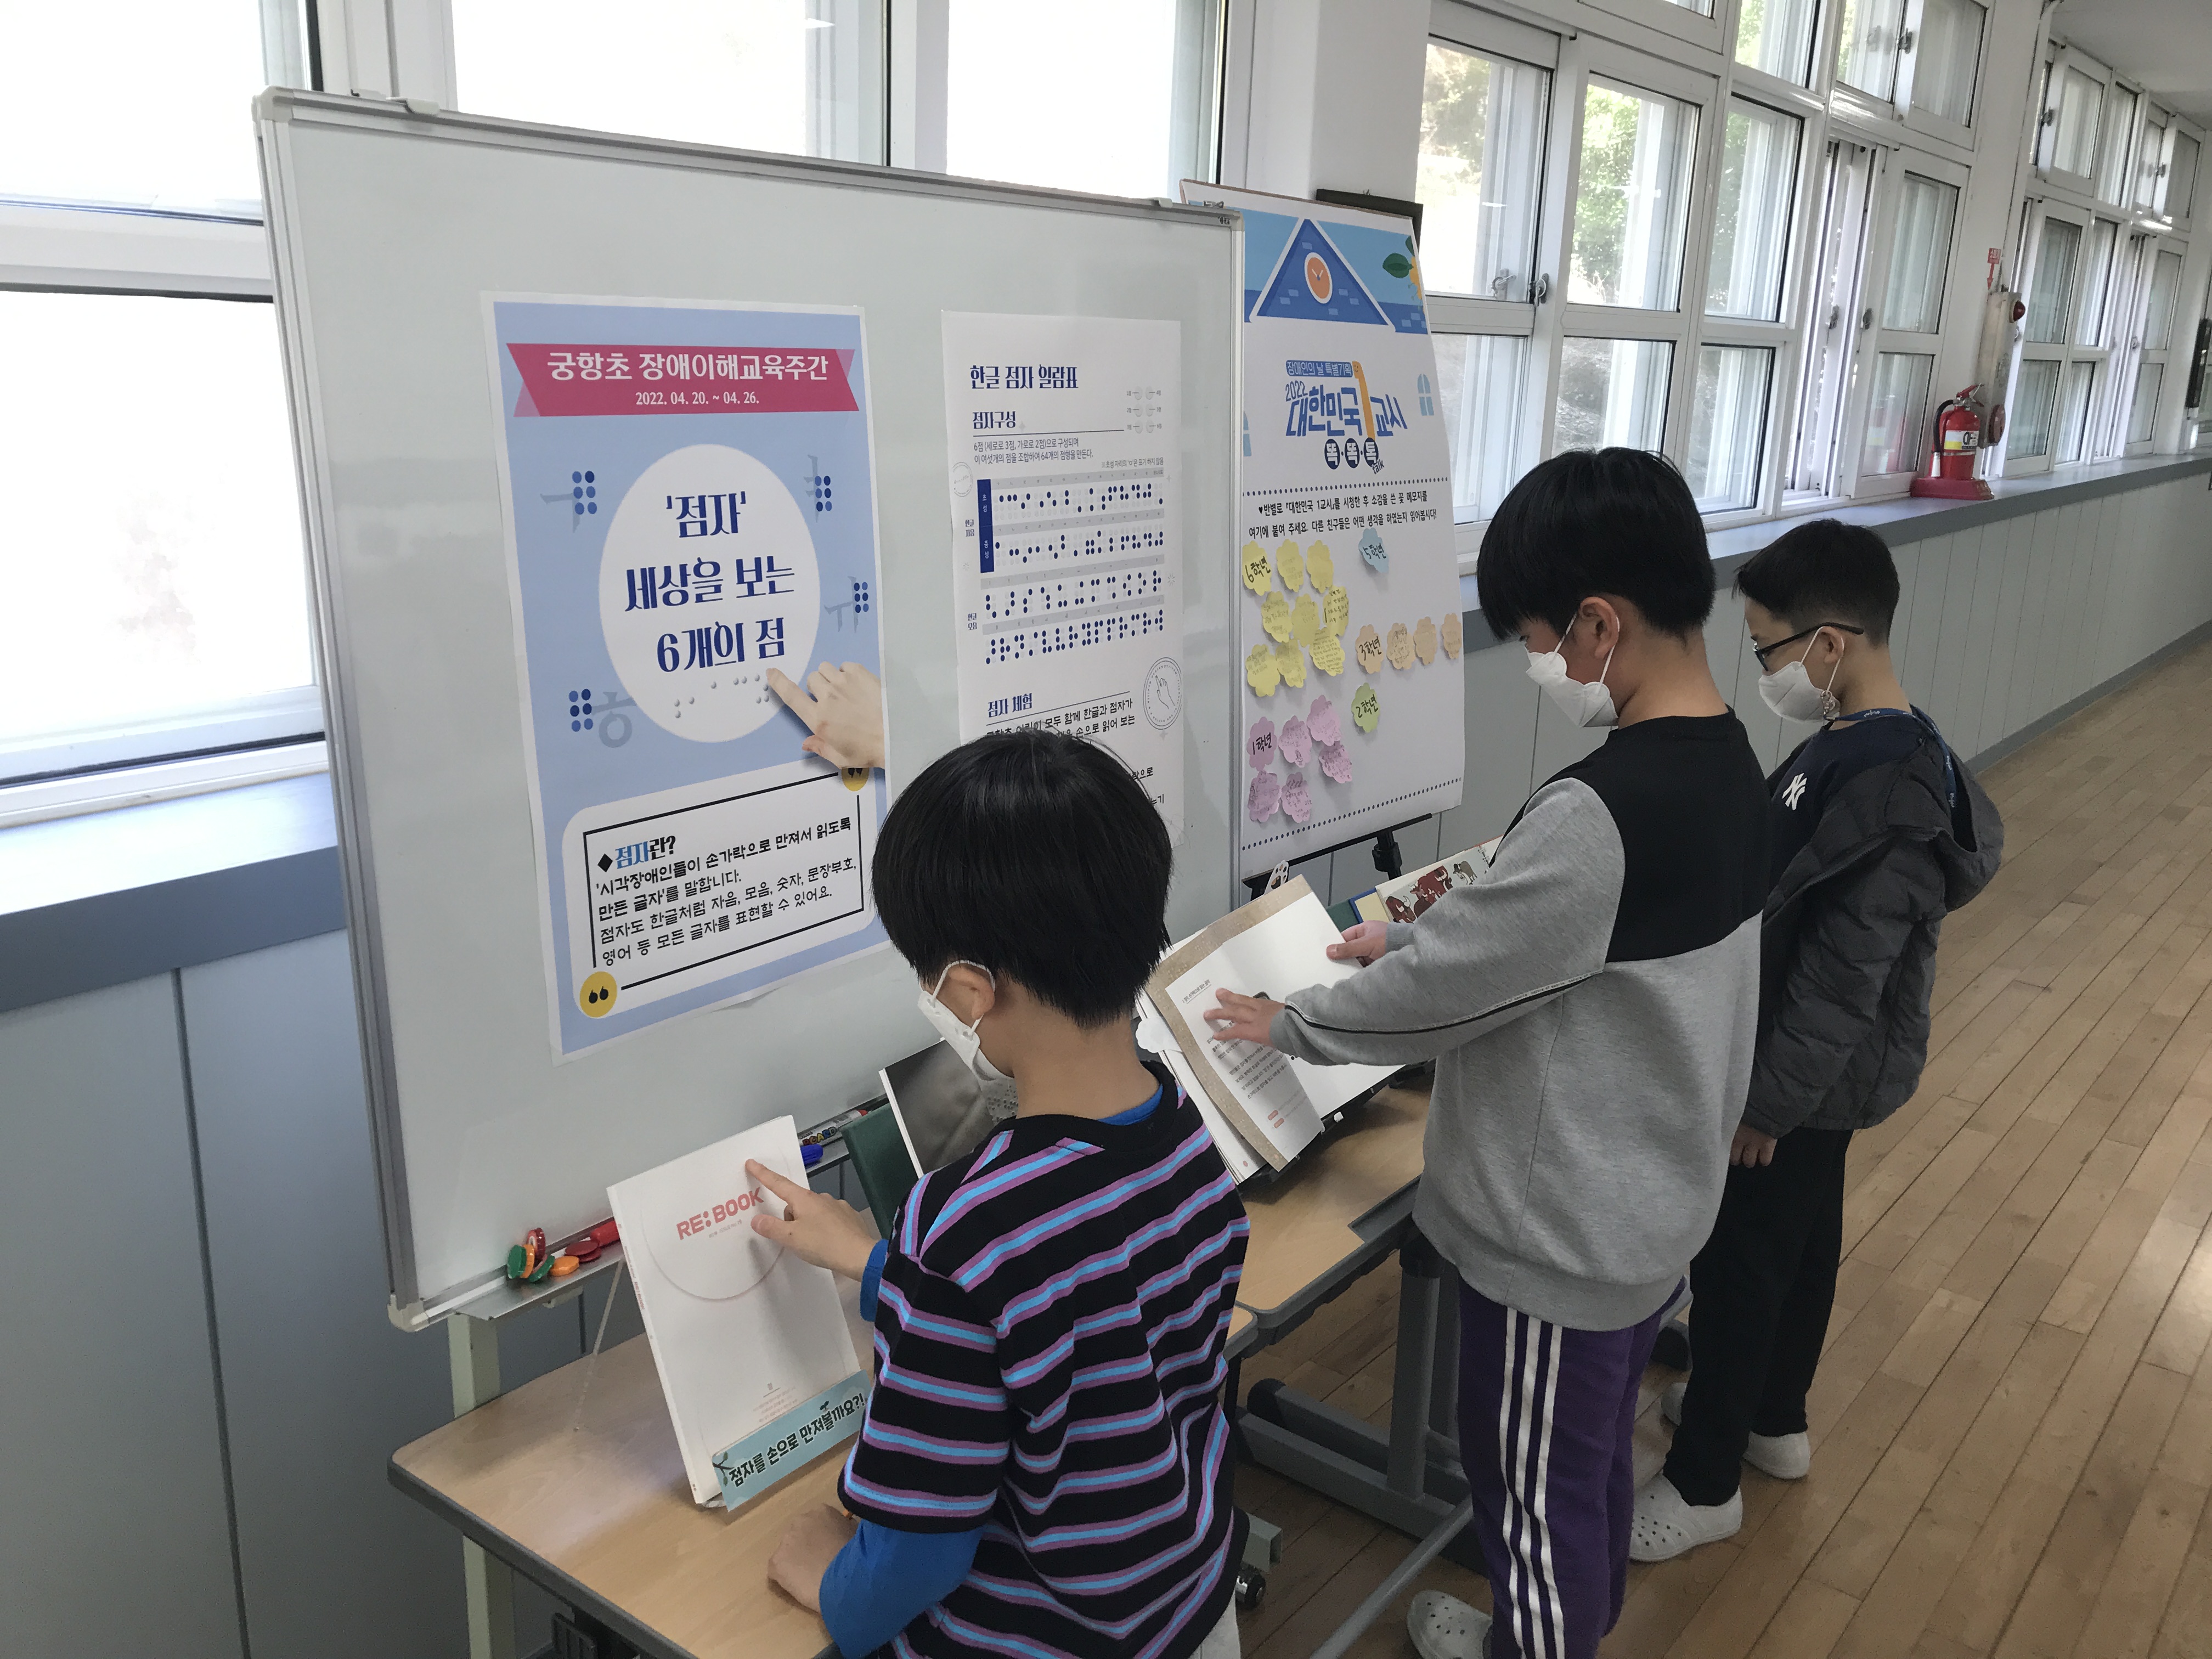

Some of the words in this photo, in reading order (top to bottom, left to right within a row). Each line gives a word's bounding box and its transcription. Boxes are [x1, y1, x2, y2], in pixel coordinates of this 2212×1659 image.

[547, 351, 633, 381] 궁항초
[639, 352, 829, 381] 장애이해교육주간
[969, 364, 1001, 389] 한글
[1005, 365, 1034, 389] 점자
[1038, 364, 1079, 389] 일람표
[1287, 362, 1316, 376] 장애인의
[1317, 362, 1324, 377] 날
[1325, 363, 1352, 377] 특별기획
[635, 391, 668, 406] 2022.
[670, 392, 689, 405] 04.
[692, 392, 709, 405] 20.
[723, 391, 741, 405] 04.
[743, 391, 760, 404] 26.
[1285, 380, 1308, 402] 2022
[972, 411, 1017, 430] 점자구성
[1285, 385, 1363, 437] 대한민국
[973, 442, 984, 452] 6점
[984, 441, 1005, 451] (세로로
[1017, 439, 1035, 449] 가로로
[1035, 438, 1058, 449] 2점)으로
[1058, 437, 1079, 448] 구성되며
[974, 454, 980, 465] 이
[981, 453, 1005, 465] 여섯개의
[1005, 453, 1017, 464] 점을
[1018, 452, 1040, 463] 조합하여
[1041, 450, 1059, 461] 64개의
[1076, 448, 1094, 460] 만든다.
[665, 490, 747, 539] '점자'
[1263, 503, 1284, 516] 반별로
[1343, 495, 1361, 509] 시청한
[1363, 494, 1369, 507] 후
[1372, 493, 1388, 506] 소감을
[1390, 493, 1396, 505] 쓴
[1406, 490, 1427, 503] 메모지를
[1249, 525, 1269, 540] 여기에
[1272, 523, 1285, 538] 붙여
[1288, 522, 1309, 535] 주세요.
[1312, 520, 1324, 533] 다른
[1327, 517, 1350, 531] 친구들은
[1353, 515, 1365, 528] 어떤
[1367, 514, 1384, 527] 생각을
[1386, 511, 1408, 524] 하였는지
[1409, 509, 1437, 522] 읽어봅시다!
[1362, 543, 1387, 560] 5학년
[1245, 556, 1271, 583] 6학년
[624, 557, 723, 612] 세상을
[736, 555, 795, 599] 보는
[657, 620, 746, 673] 6개의
[755, 617, 786, 659] 점
[1358, 635, 1382, 661] 3학년
[988, 698, 1009, 718] 점자
[1012, 692, 1033, 713] 체험
[1045, 715, 1062, 729] 모두
[1064, 710, 1081, 725] 함께
[1084, 704, 1108, 720] 한글과
[1110, 698, 1133, 714] 점자가
[1356, 693, 1379, 719] 2학년
[1102, 718, 1118, 732] 읽어
[1120, 714, 1136, 727] 보는
[1252, 731, 1272, 755] 1학년
[596, 856, 702, 896] '시각장애인들이
[706, 838, 771, 870] 손가락으로
[775, 826, 813, 851] 만져서
[816, 816, 852, 840] 읽도록
[614, 834, 677, 869] 점자란?
[598, 901, 628, 922] 만든
[633, 885, 680, 913] 글자'를
[685, 868, 742, 899] 말합니다.
[600, 919, 645, 945] 점자도
[650, 900, 706, 930] 한글처럼
[711, 890, 741, 911] 자음,
[745, 881, 773, 903] 모음,
[776, 872, 804, 894] 숫자,
[807, 856, 857, 884] 문장부호,
[602, 945, 632, 968] 영어
[637, 939, 652, 957] 등
[657, 929, 686, 951] 모든
[690, 912, 731, 942] 글자를
[735, 901, 774, 926] 표현할
[777, 896, 791, 913] 수
[794, 885, 833, 909] 있어요.
[676, 1187, 764, 1240] RE:BOOK
[727, 1452, 766, 1488] 점자를
[766, 1432, 799, 1466] 손으로
[799, 1392, 865, 1444] 만져볼까요?!
